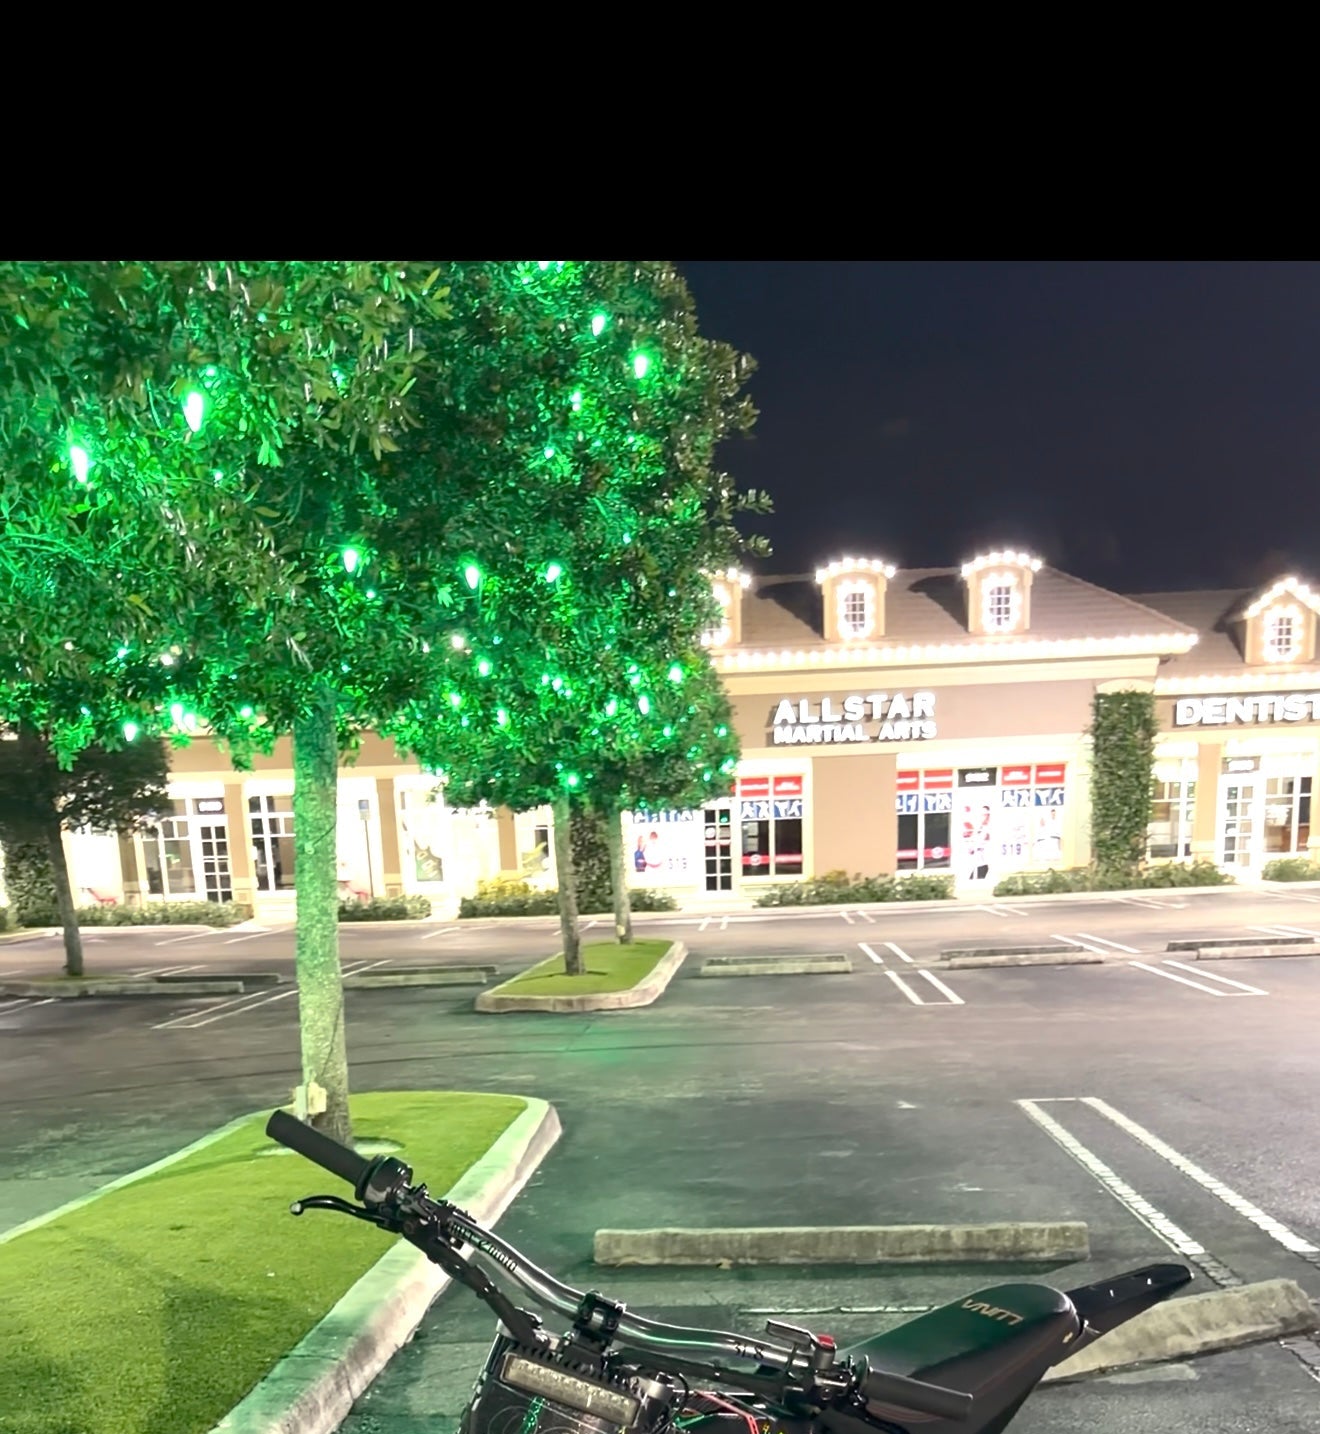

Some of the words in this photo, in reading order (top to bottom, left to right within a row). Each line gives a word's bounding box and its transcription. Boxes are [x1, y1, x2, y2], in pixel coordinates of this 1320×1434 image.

[773, 692, 936, 725] ALLSTAR
[1176, 694, 1320, 726] DENTIST
[774, 724, 871, 744] MARTIAL
[878, 720, 938, 741] ARTS
